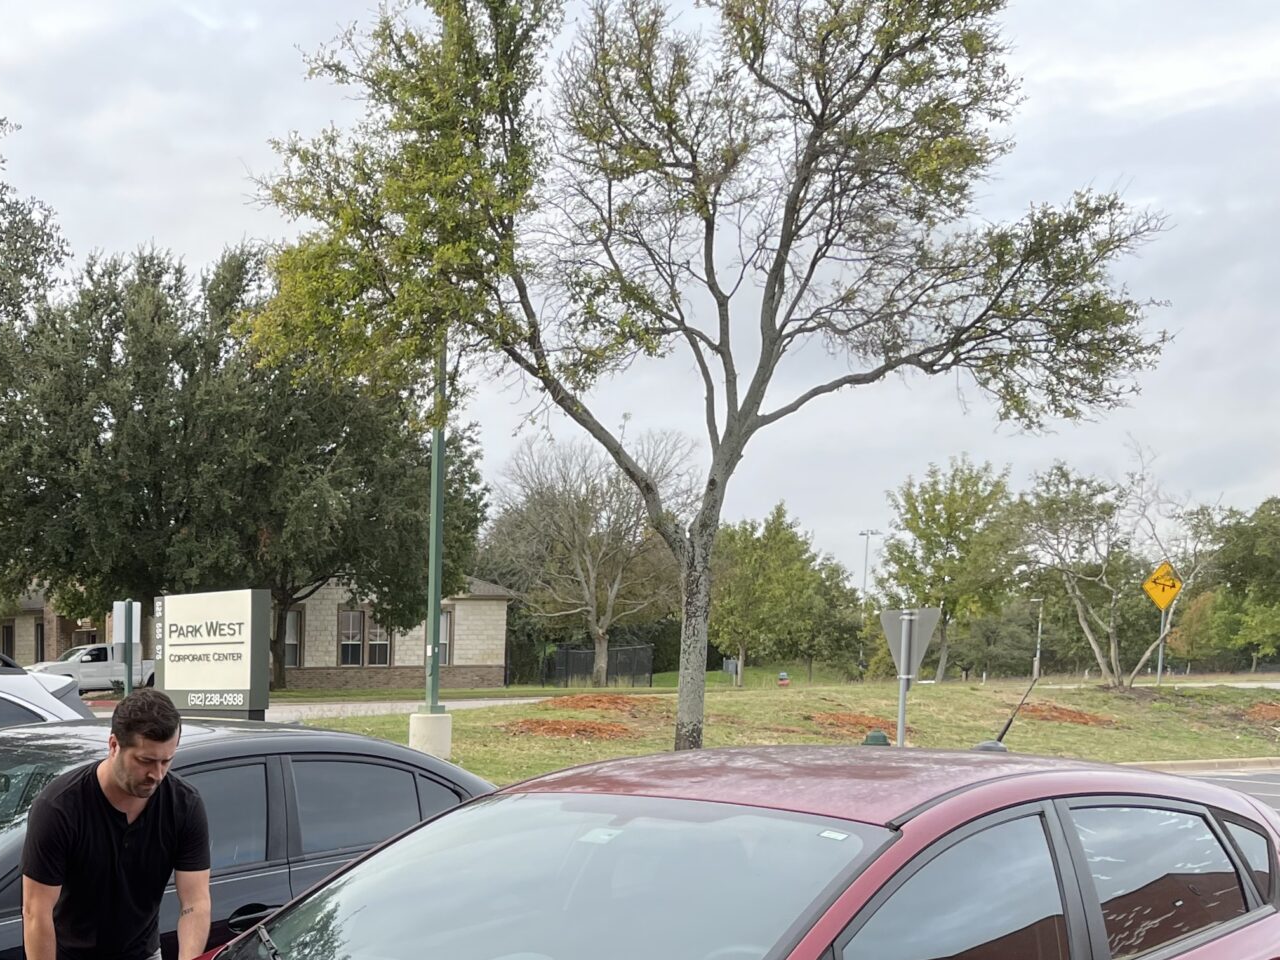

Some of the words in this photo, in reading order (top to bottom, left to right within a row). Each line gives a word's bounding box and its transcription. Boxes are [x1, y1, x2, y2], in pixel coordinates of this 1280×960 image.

[168, 623, 203, 638] PARK
[205, 621, 244, 637] WEST
[168, 653, 211, 663] CORPORATE
[212, 652, 243, 662] CENTER
[187, 692, 205, 707] (512)
[205, 693, 244, 706] 238-0938
